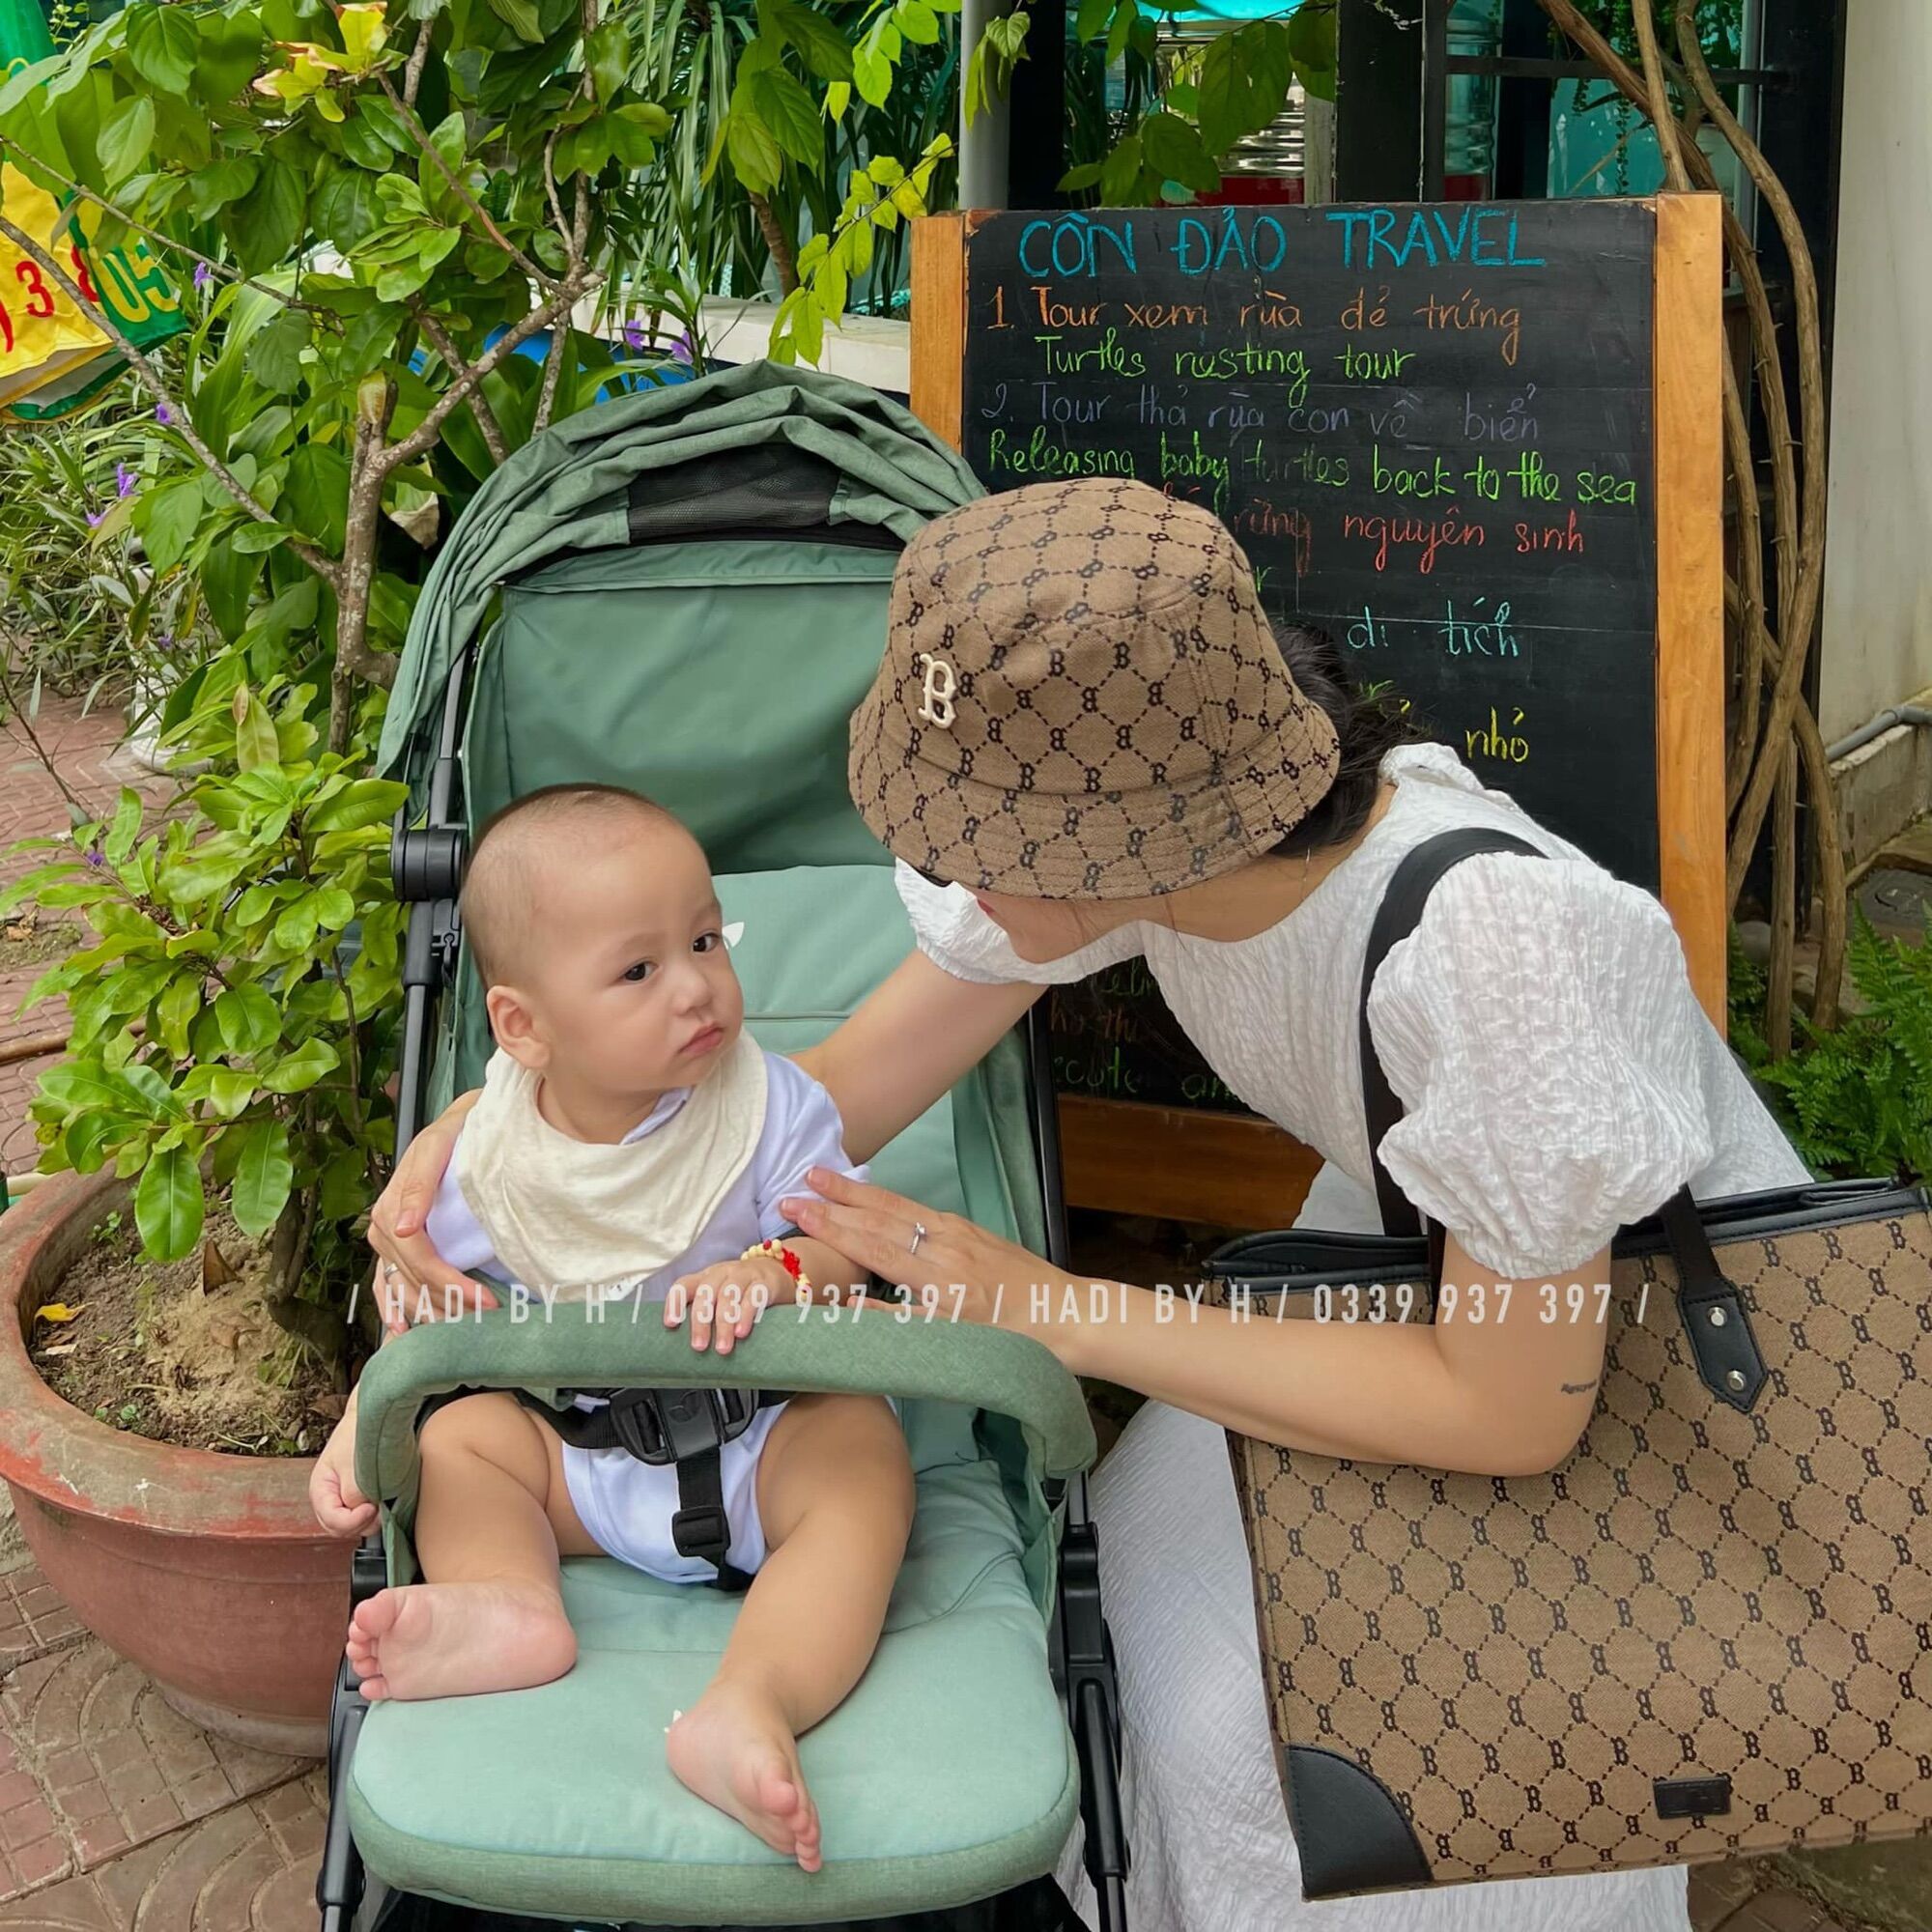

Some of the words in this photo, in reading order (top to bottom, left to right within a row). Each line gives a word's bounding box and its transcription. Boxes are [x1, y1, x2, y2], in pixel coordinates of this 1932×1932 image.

[1019, 212, 1137, 277] CÔN
[1325, 207, 1546, 269] TRAVEL
[1031, 286, 1108, 327] Tour
[1123, 302, 1208, 329] xem
[1035, 327, 1147, 377] Turtles
[1334, 343, 1416, 380] tour
[1031, 382, 1112, 423] Tour
[1288, 407, 1350, 433] con
[988, 425, 1136, 480] Releasing
[1159, 431, 1232, 516] baby
[1241, 438, 1350, 488] turtles
[1372, 443, 1456, 498] back
[1463, 455, 1499, 501] to
[1507, 450, 1561, 502] the
[1577, 470, 1637, 506] sea
[1344, 505, 1486, 574] nguyên
[1514, 508, 1585, 554] sinh
[918, 652, 957, 729] B
